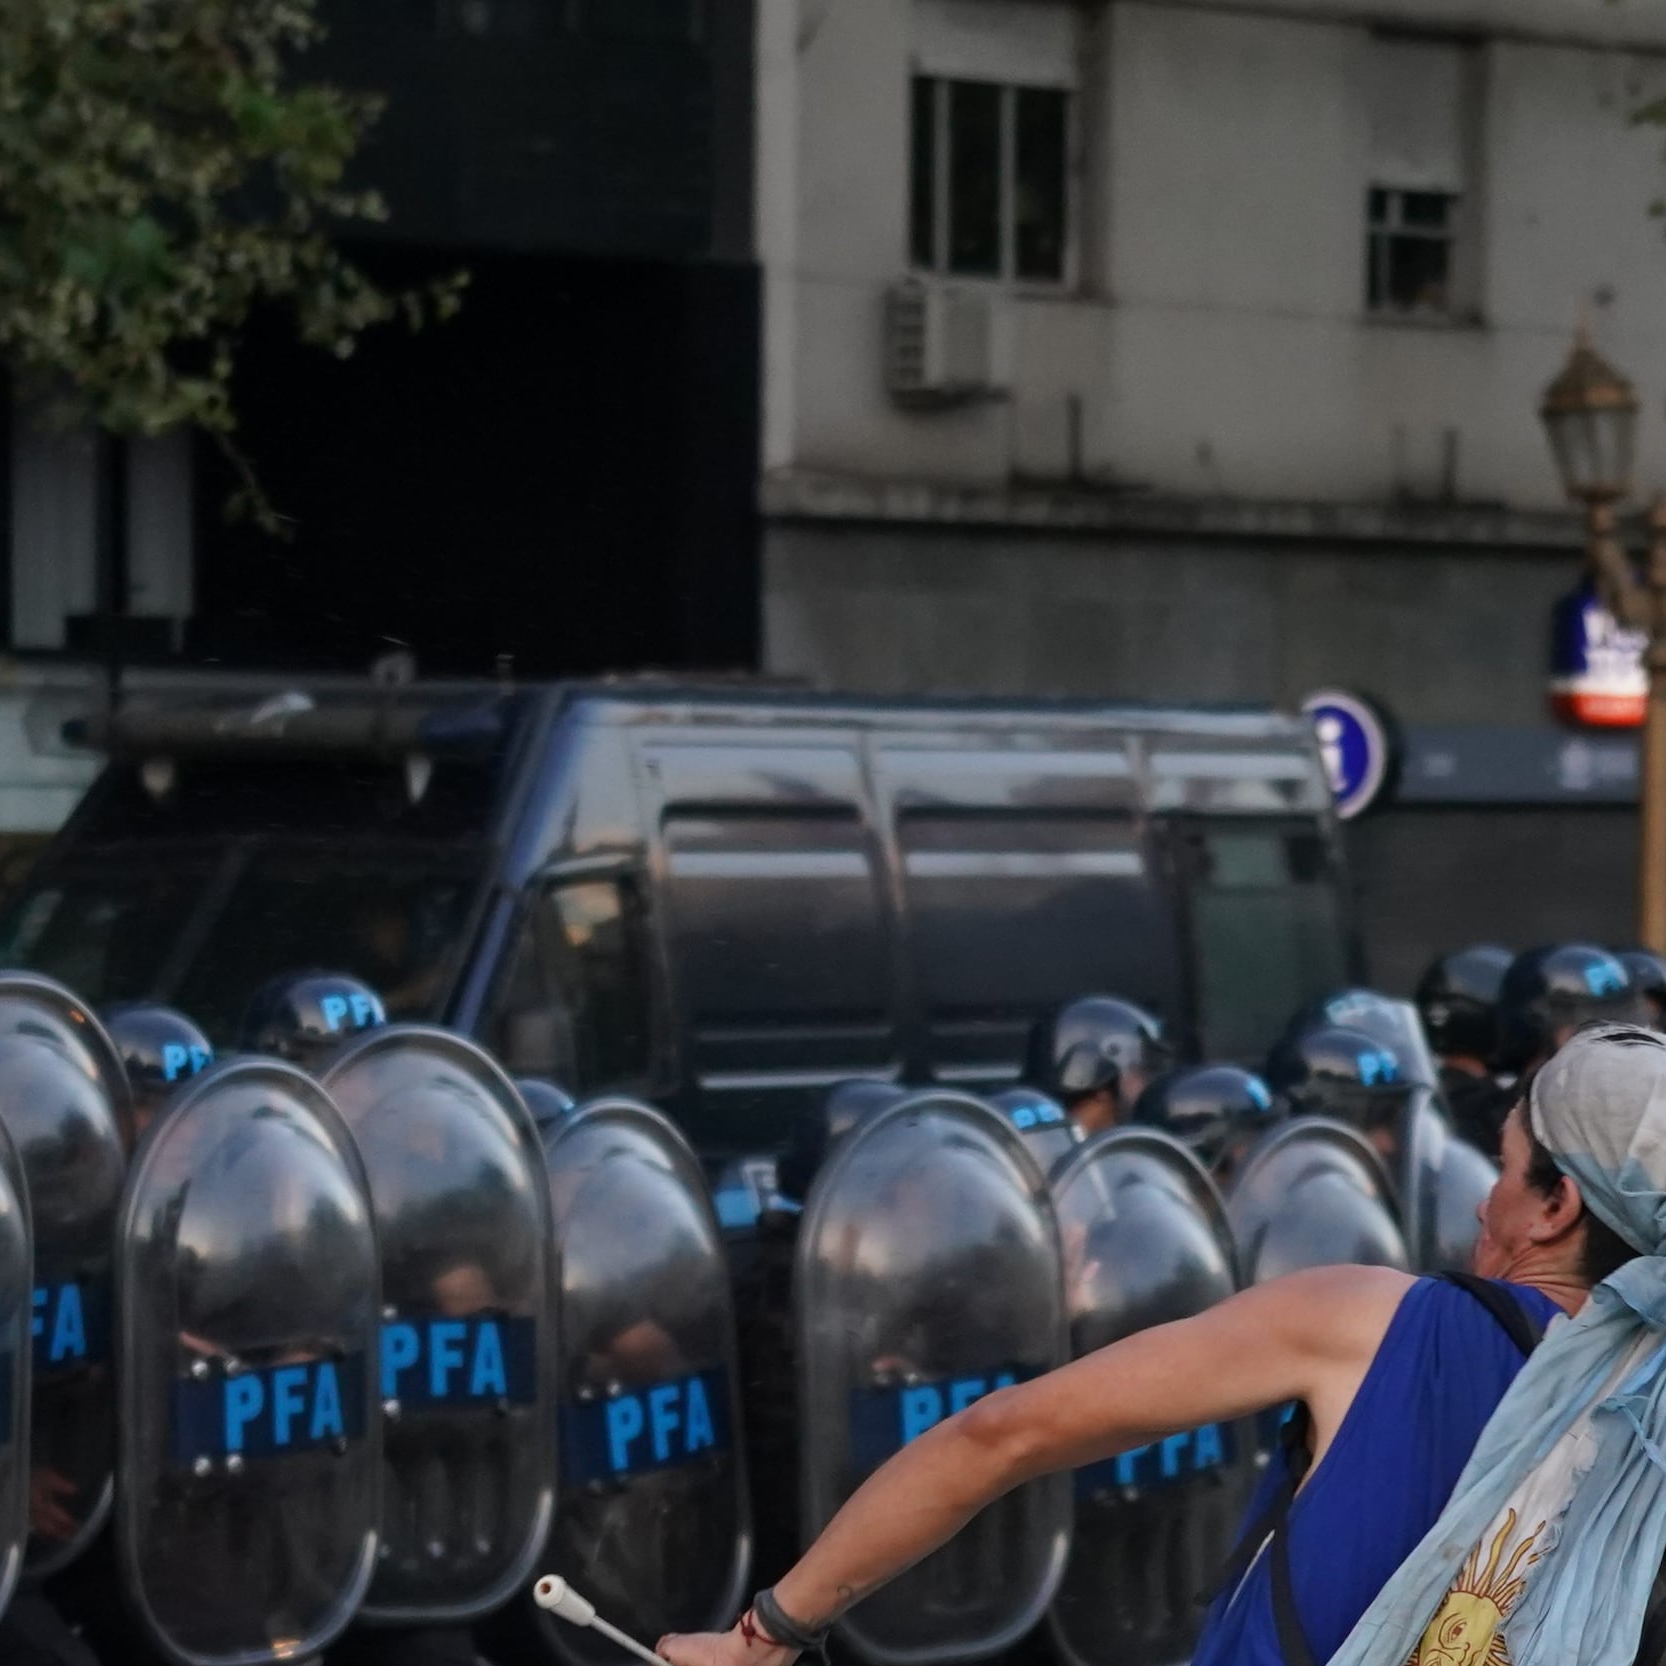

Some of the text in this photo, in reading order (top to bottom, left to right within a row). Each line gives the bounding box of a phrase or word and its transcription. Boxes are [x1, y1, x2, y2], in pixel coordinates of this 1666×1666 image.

[378, 1320, 507, 1399] PFA
[225, 1360, 344, 1453] PFA
[606, 1376, 714, 1473] PFA
